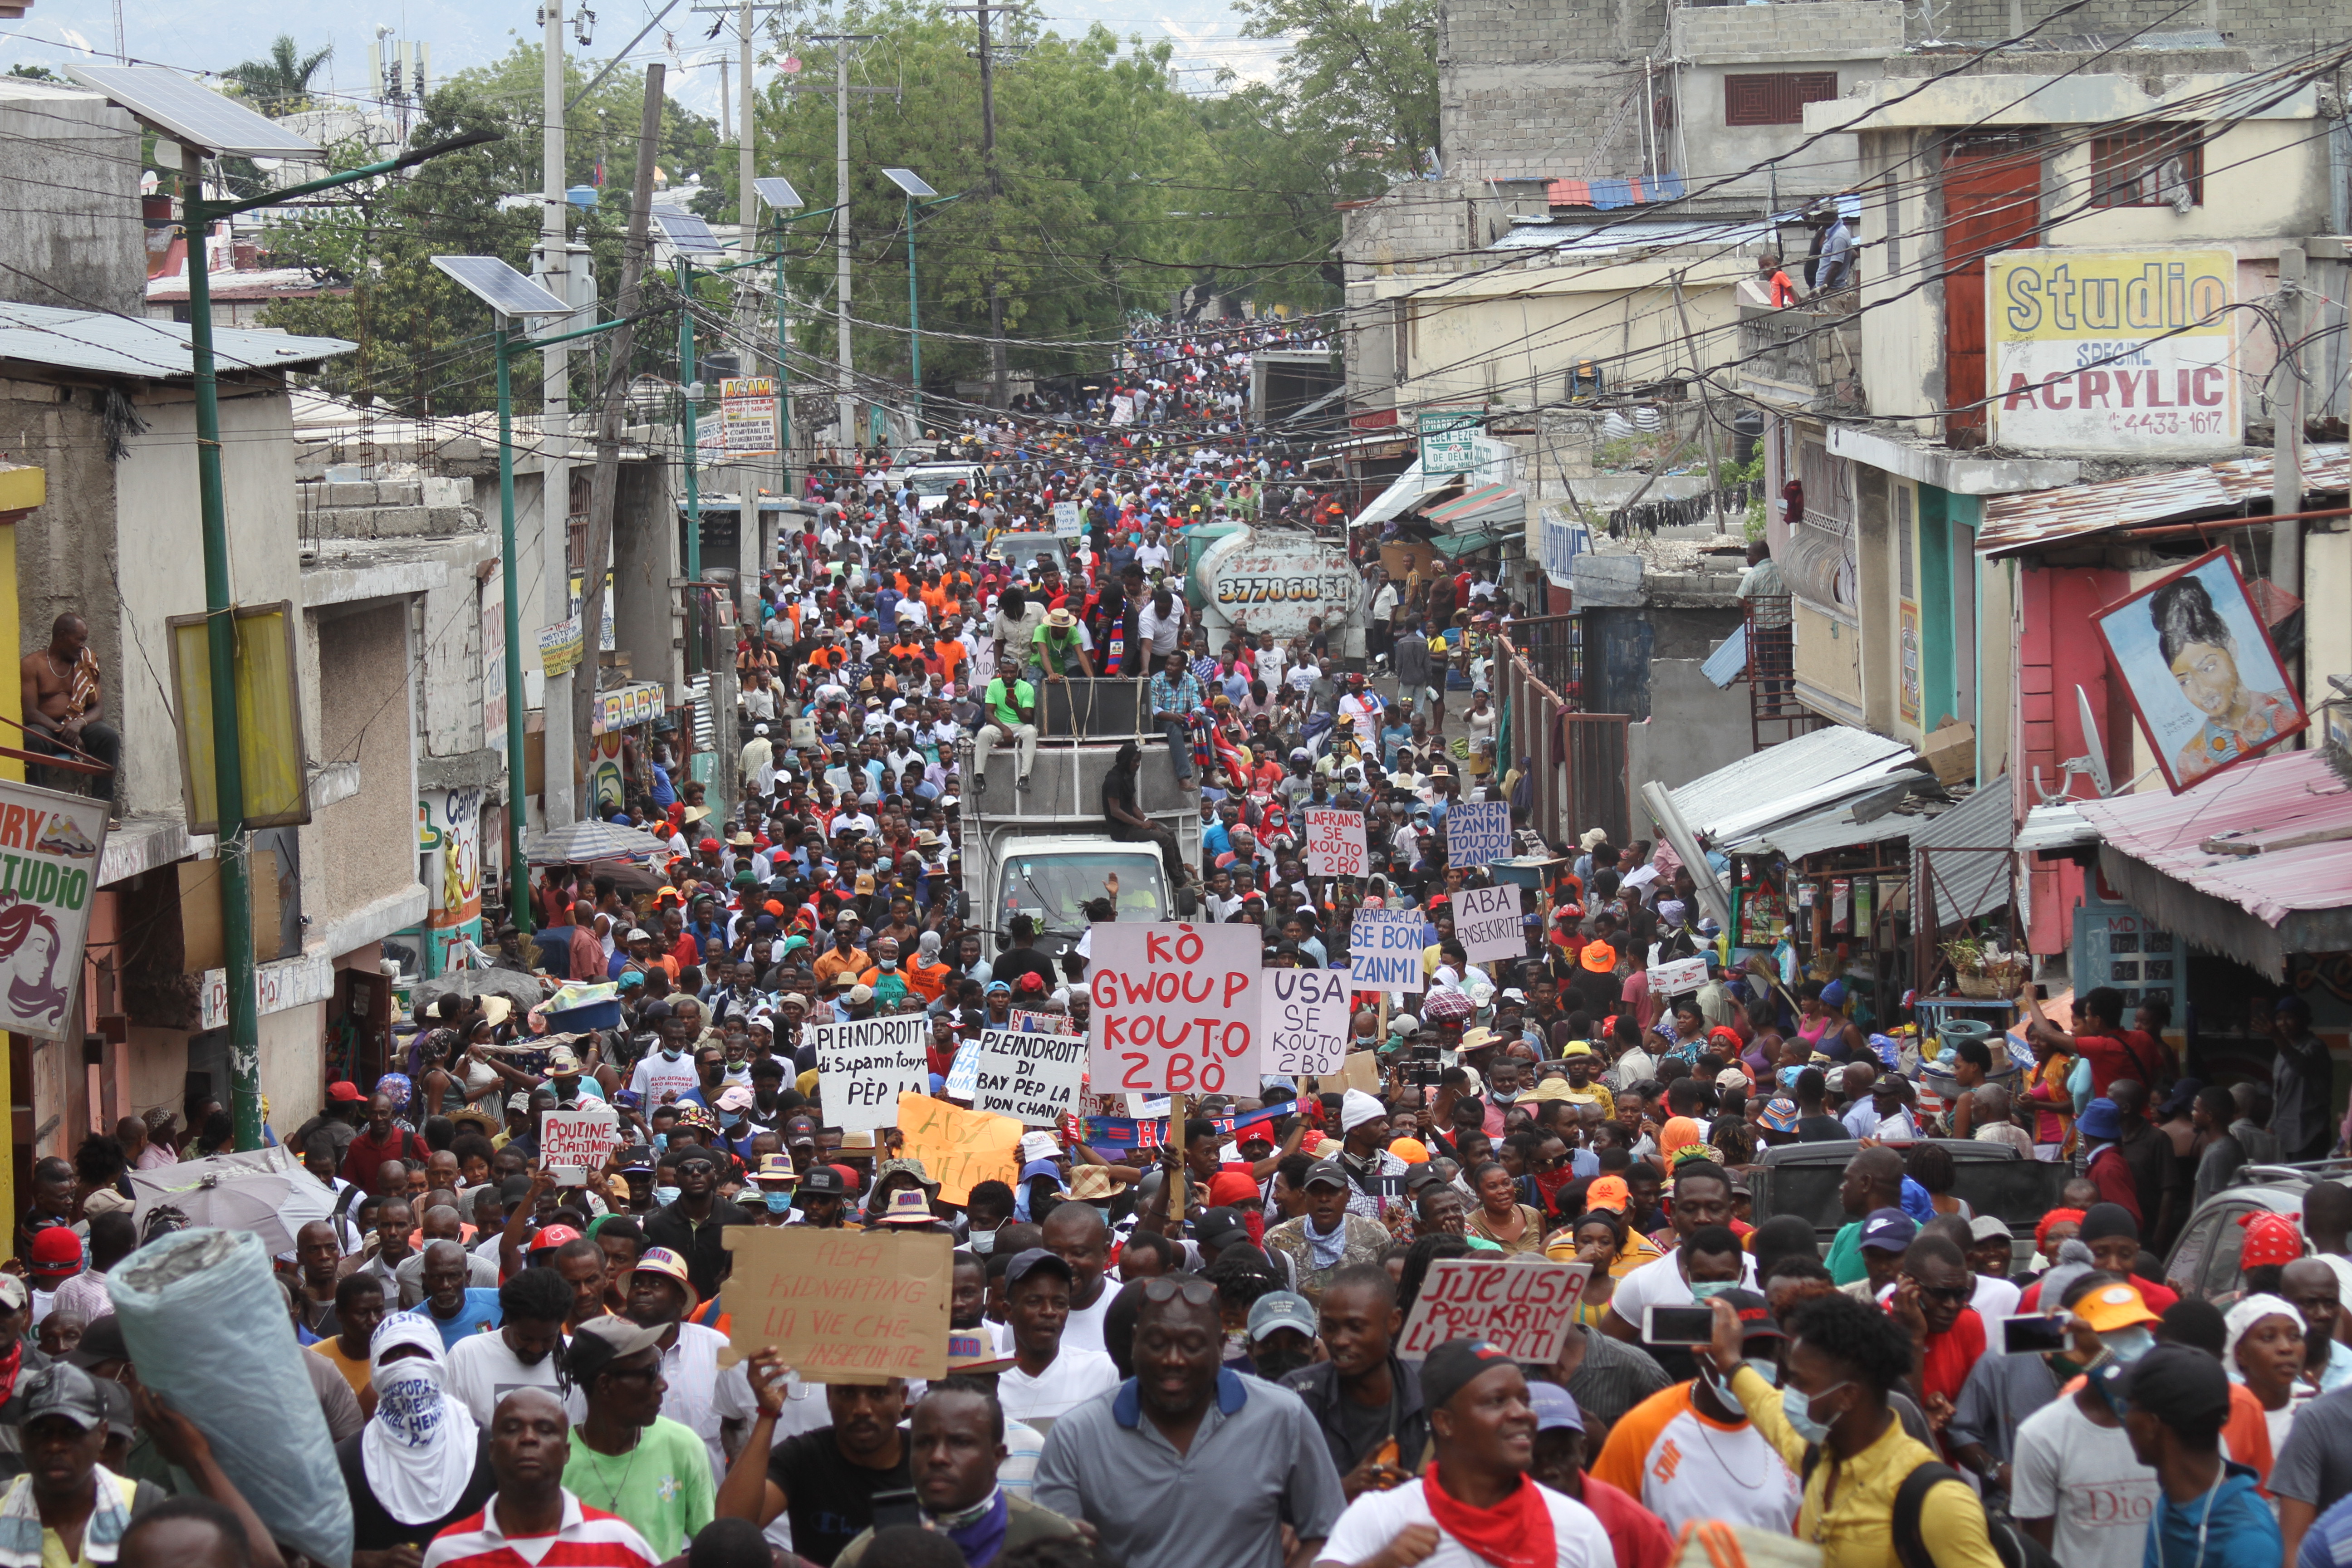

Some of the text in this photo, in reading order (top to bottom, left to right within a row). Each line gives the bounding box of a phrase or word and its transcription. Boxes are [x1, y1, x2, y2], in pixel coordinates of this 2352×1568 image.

[2007, 263, 2226, 332] Studio
[2003, 368, 2223, 410] ACRYLIC
[1433, 453, 1443, 462] DE
[542, 625, 577, 642] INSTITUTION
[555, 621, 570, 631] IMG
[539, 639, 558, 650] MIXTE
[605, 684, 664, 731] BABY
[446, 787, 480, 825] Center
[1305, 811, 1361, 829] LAFRANS
[1448, 802, 1506, 820] ANSYEN
[1323, 826, 1343, 841] SE
[1449, 817, 1505, 835] ZANMI
[1309, 839, 1362, 857] KOUTO
[1448, 834, 1510, 851] TOUJOU
[1323, 856, 1335, 873] 2
[1449, 849, 1504, 867] ZANMI
[1462, 887, 1511, 916] ABA
[1355, 908, 1421, 926] VENEZWELA
[1456, 916, 1524, 946] ENSEKIRITE
[1147, 924, 1203, 964] KÒ
[1352, 924, 1422, 951] SE BON
[1352, 955, 1415, 984] ZANMI
[1092, 969, 1249, 1009] GWOUP
[1275, 971, 1344, 1004] USA
[1284, 1004, 1321, 1033] SE
[818, 1020, 923, 1050] PLEINDROIT
[980, 1031, 1085, 1064] PLEINDROIT
[1104, 1014, 1250, 1057] KOUTO
[1273, 1031, 1342, 1055] KOUTO
[818, 1056, 830, 1074] di
[1015, 1060, 1034, 1076] DI
[1122, 1051, 1225, 1093] 2 BÒ
[1279, 1053, 1296, 1073] 2
[848, 1077, 887, 1106] PÈP
[977, 1072, 1070, 1103] BAY PEP LA
[984, 1095, 1013, 1111] YON
[546, 1118, 612, 1140] POUTINE
[918, 1107, 995, 1148] ABA
[816, 1240, 882, 1269] ABA
[769, 1273, 928, 1303] KIDNAPPING
[1507, 1269, 1585, 1305] USA
[764, 1307, 795, 1338] LA
[812, 1309, 844, 1335] VIE
